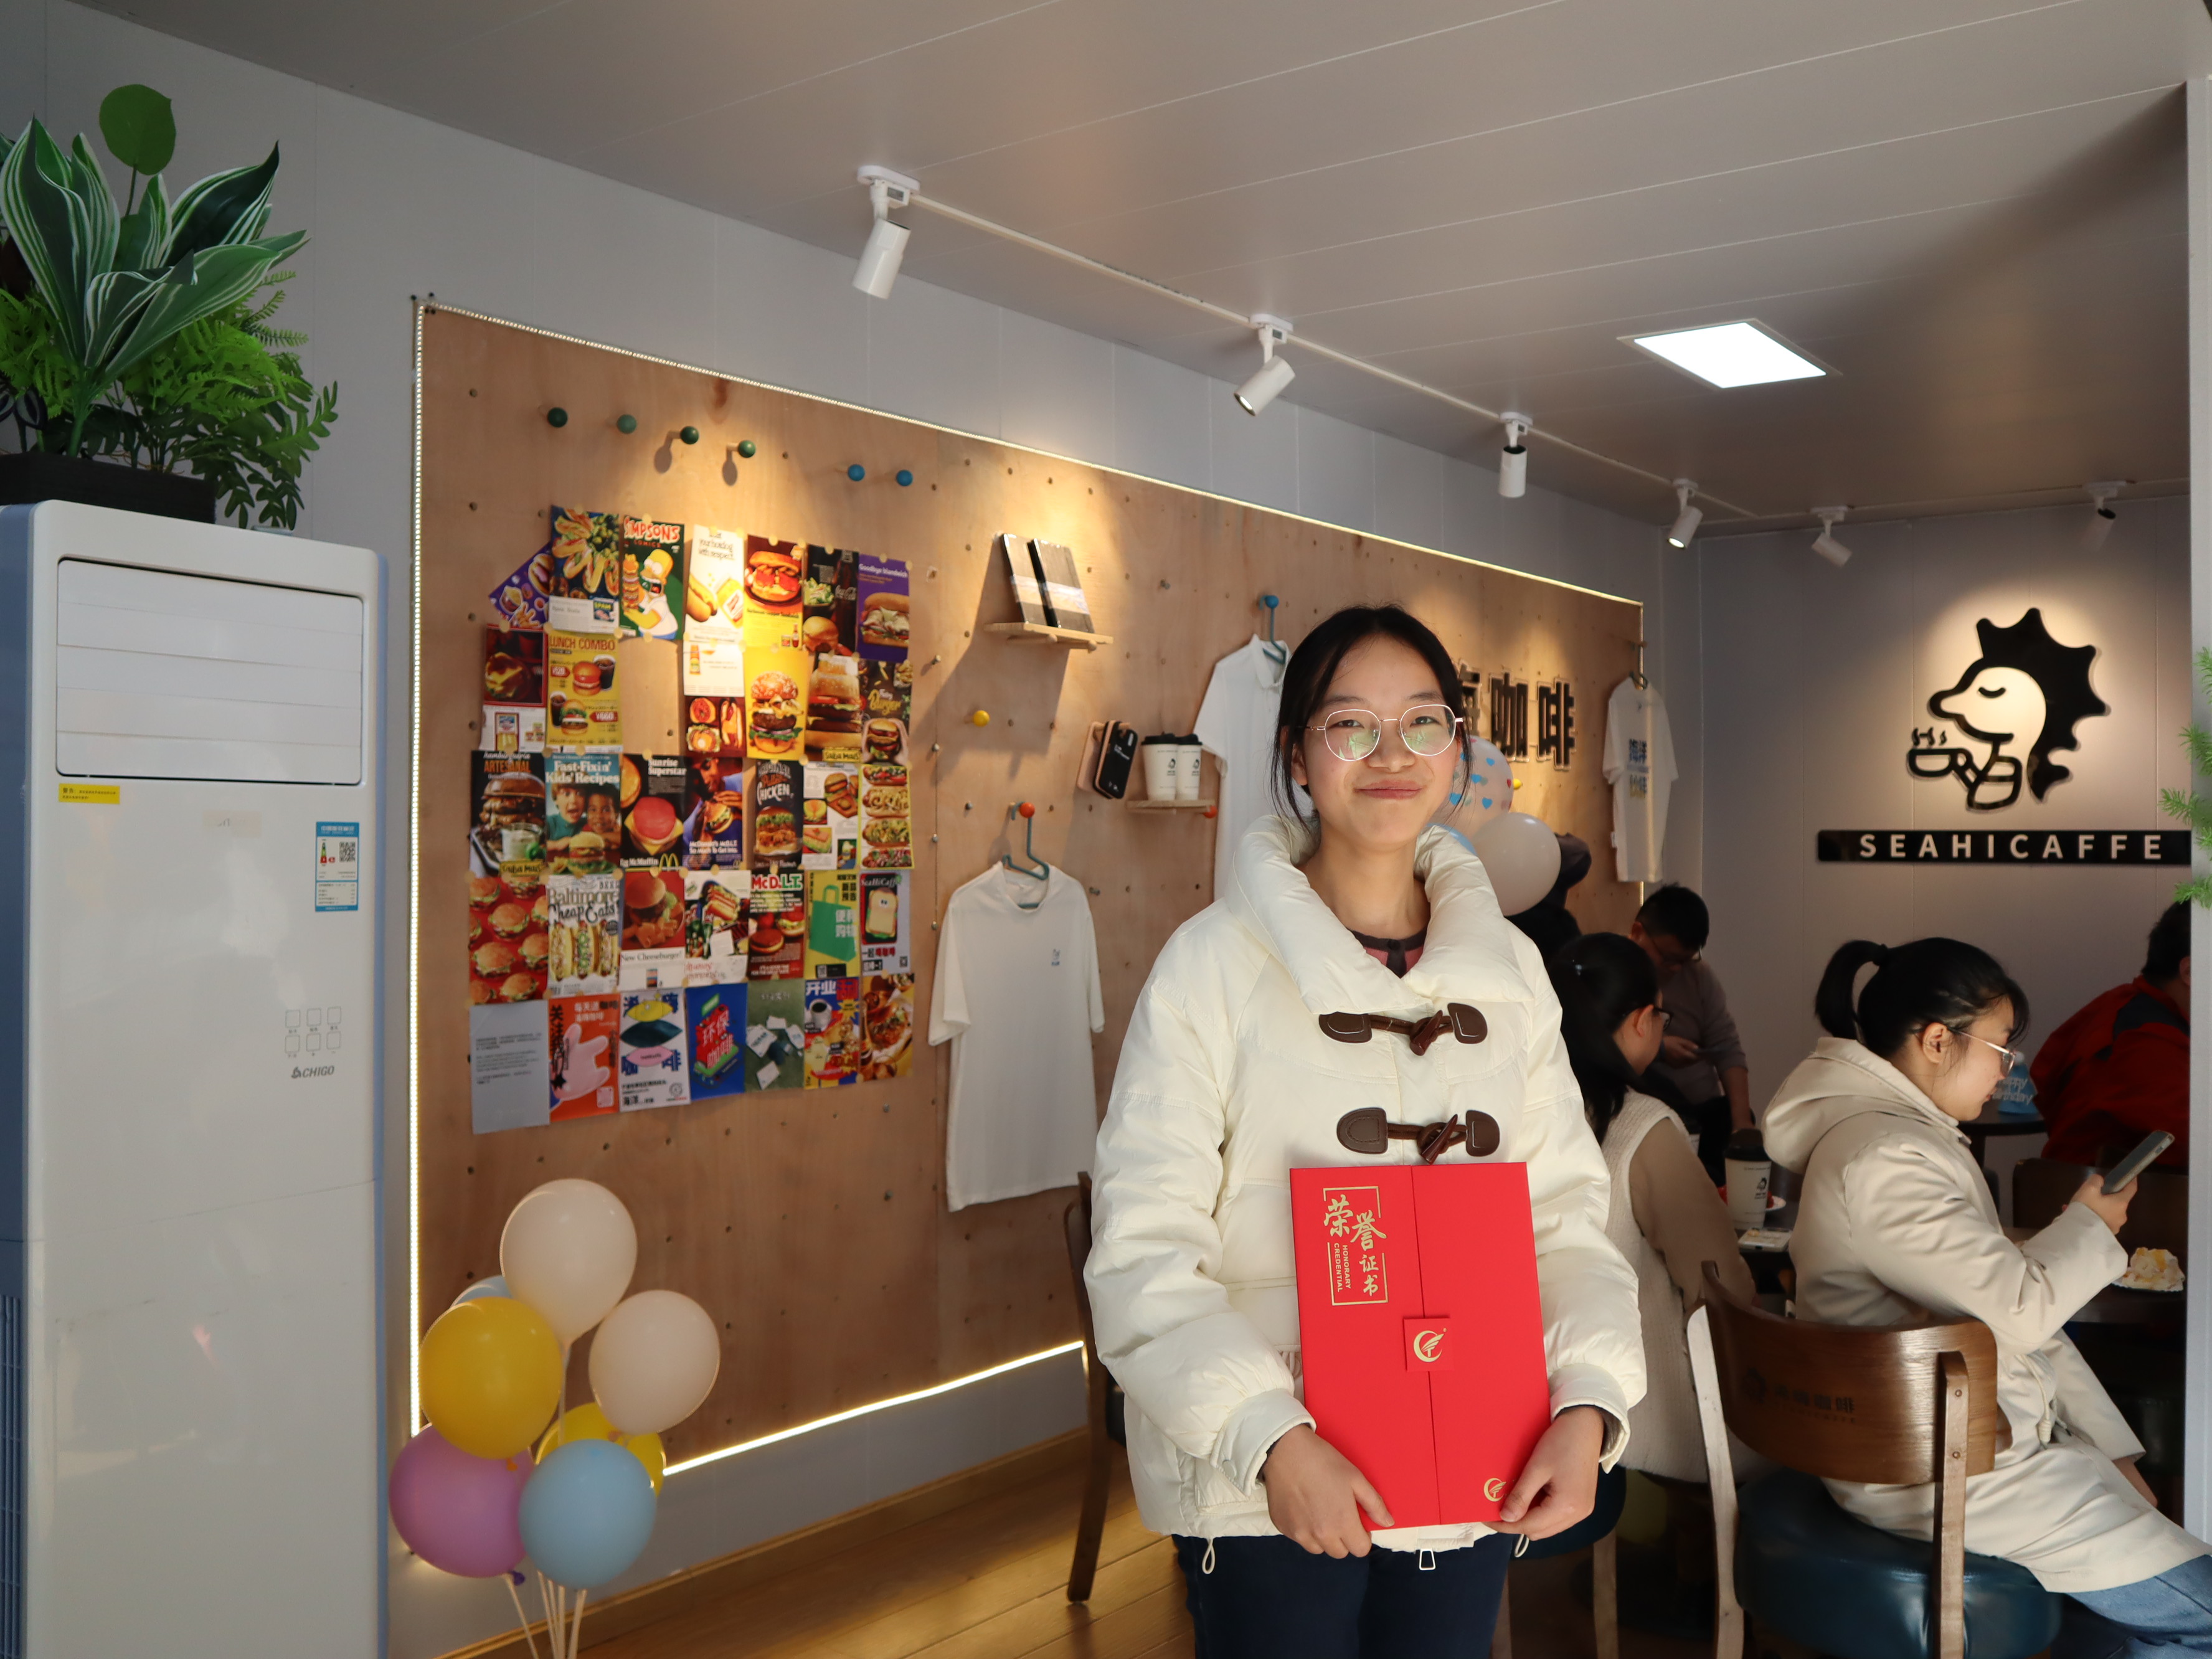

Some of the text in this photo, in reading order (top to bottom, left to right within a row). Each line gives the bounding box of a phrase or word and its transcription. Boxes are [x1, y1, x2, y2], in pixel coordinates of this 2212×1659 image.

[625, 515, 681, 544] SIMPSONS
[549, 636, 615, 650] LUNCH COMBO
[484, 760, 532, 773] ARTESANAL
[648, 758, 678, 767] Sunrise
[575, 772, 620, 786] Recipes
[648, 767, 687, 777] Superstar
[1860, 834, 2162, 860] SEAHICAFFE
[629, 857, 659, 867] McMuffin
[548, 888, 620, 905] Baltimore
[549, 900, 615, 927] Cheap Eats
[806, 980, 836, 996] 开业
[302, 1065, 335, 1078] CHIGO
[1323, 1194, 1387, 1297] 荣誉证书
[1333, 1242, 1343, 1292] CREDENTIAL
[1342, 1244, 1351, 1290] HONORARY
